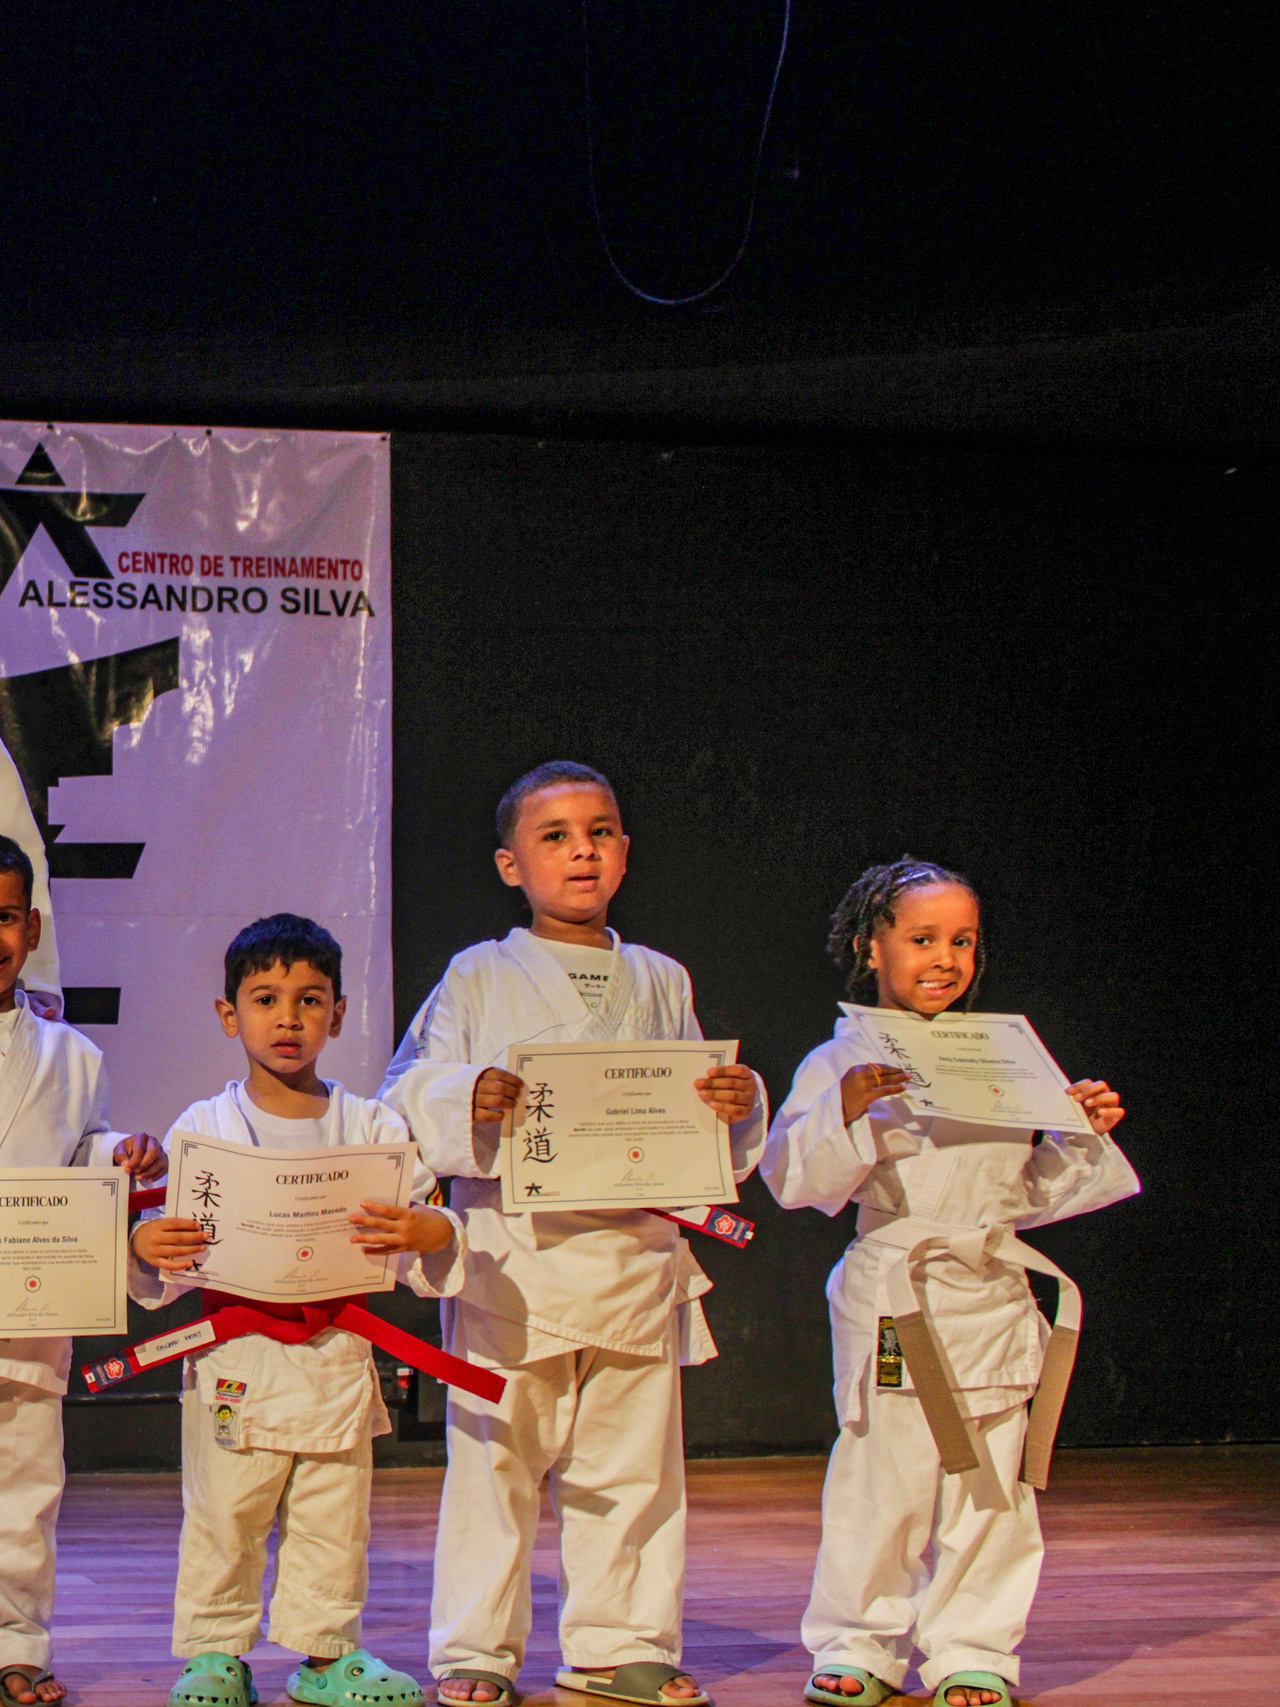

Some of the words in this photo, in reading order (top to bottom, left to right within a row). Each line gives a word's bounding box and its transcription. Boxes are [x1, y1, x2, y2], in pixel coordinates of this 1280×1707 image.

[118, 551, 193, 576] CENTRO
[200, 554, 224, 577] DE
[230, 555, 363, 581] TREINAMENTO
[19, 579, 268, 614] ALESSANDRO
[280, 586, 376, 618] SILVA
[931, 1030, 989, 1040] CERTIFICADO
[604, 1067, 672, 1079] CERTIFICADO
[606, 1107, 629, 1115] Gabriel
[631, 1107, 647, 1115] Lima
[275, 1170, 349, 1185] CERTIFICADO
[269, 1210, 290, 1218] Lucas
[292, 1210, 319, 1218] Martins
[321, 1206, 347, 1216] Macedo
[4, 1236, 31, 1244] Fabiano
[32, 1236, 50, 1244] Alves
[52, 1235, 60, 1243] da
[61, 1235, 78, 1243] Silva
